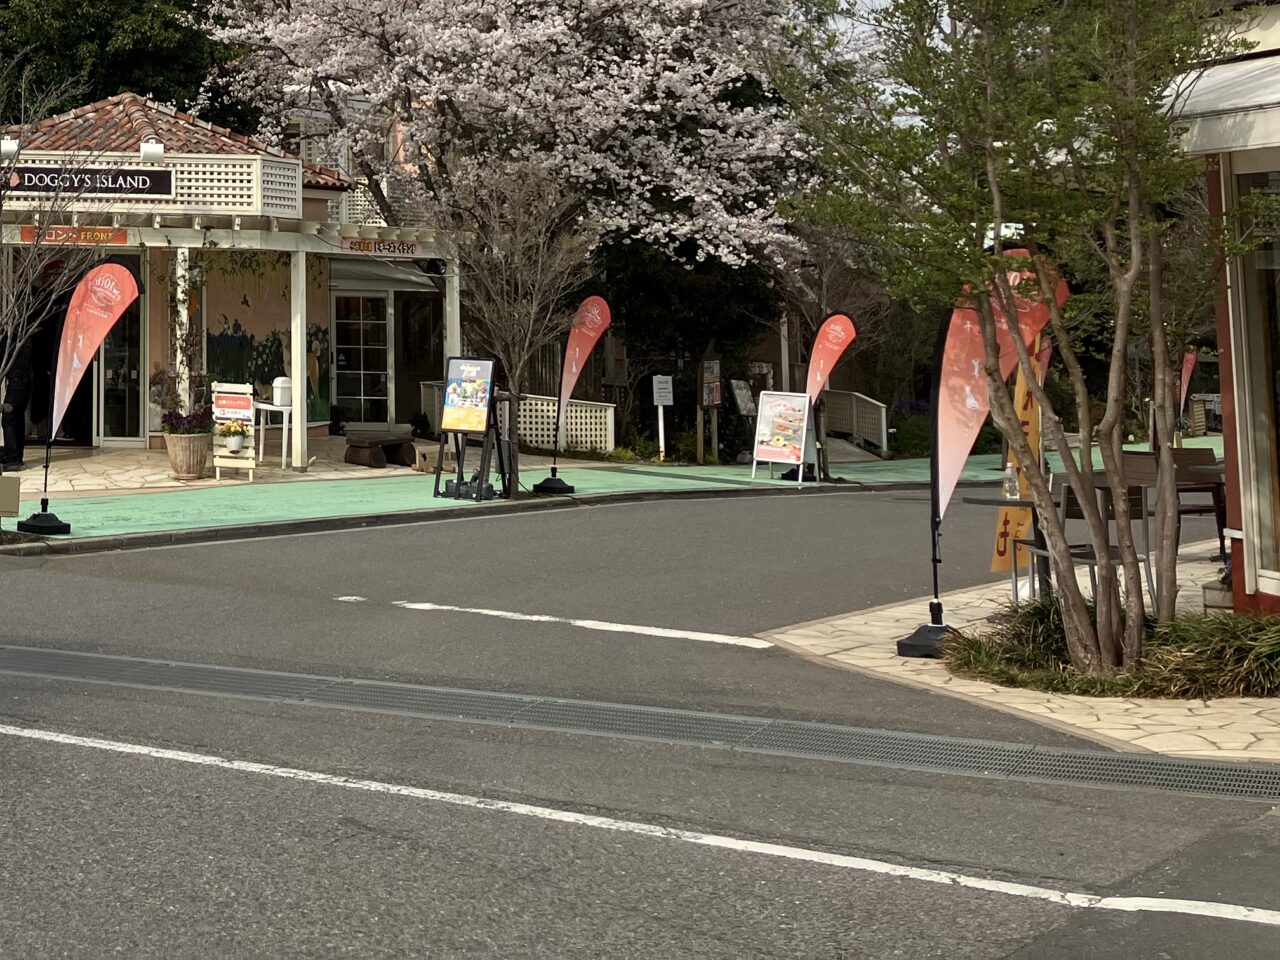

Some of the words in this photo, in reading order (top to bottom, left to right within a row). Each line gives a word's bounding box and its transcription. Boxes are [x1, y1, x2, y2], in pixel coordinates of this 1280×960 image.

[24, 173, 91, 187] DOGGY'S
[96, 174, 150, 189] ISLAND
[81, 231, 114, 241] FRONT
